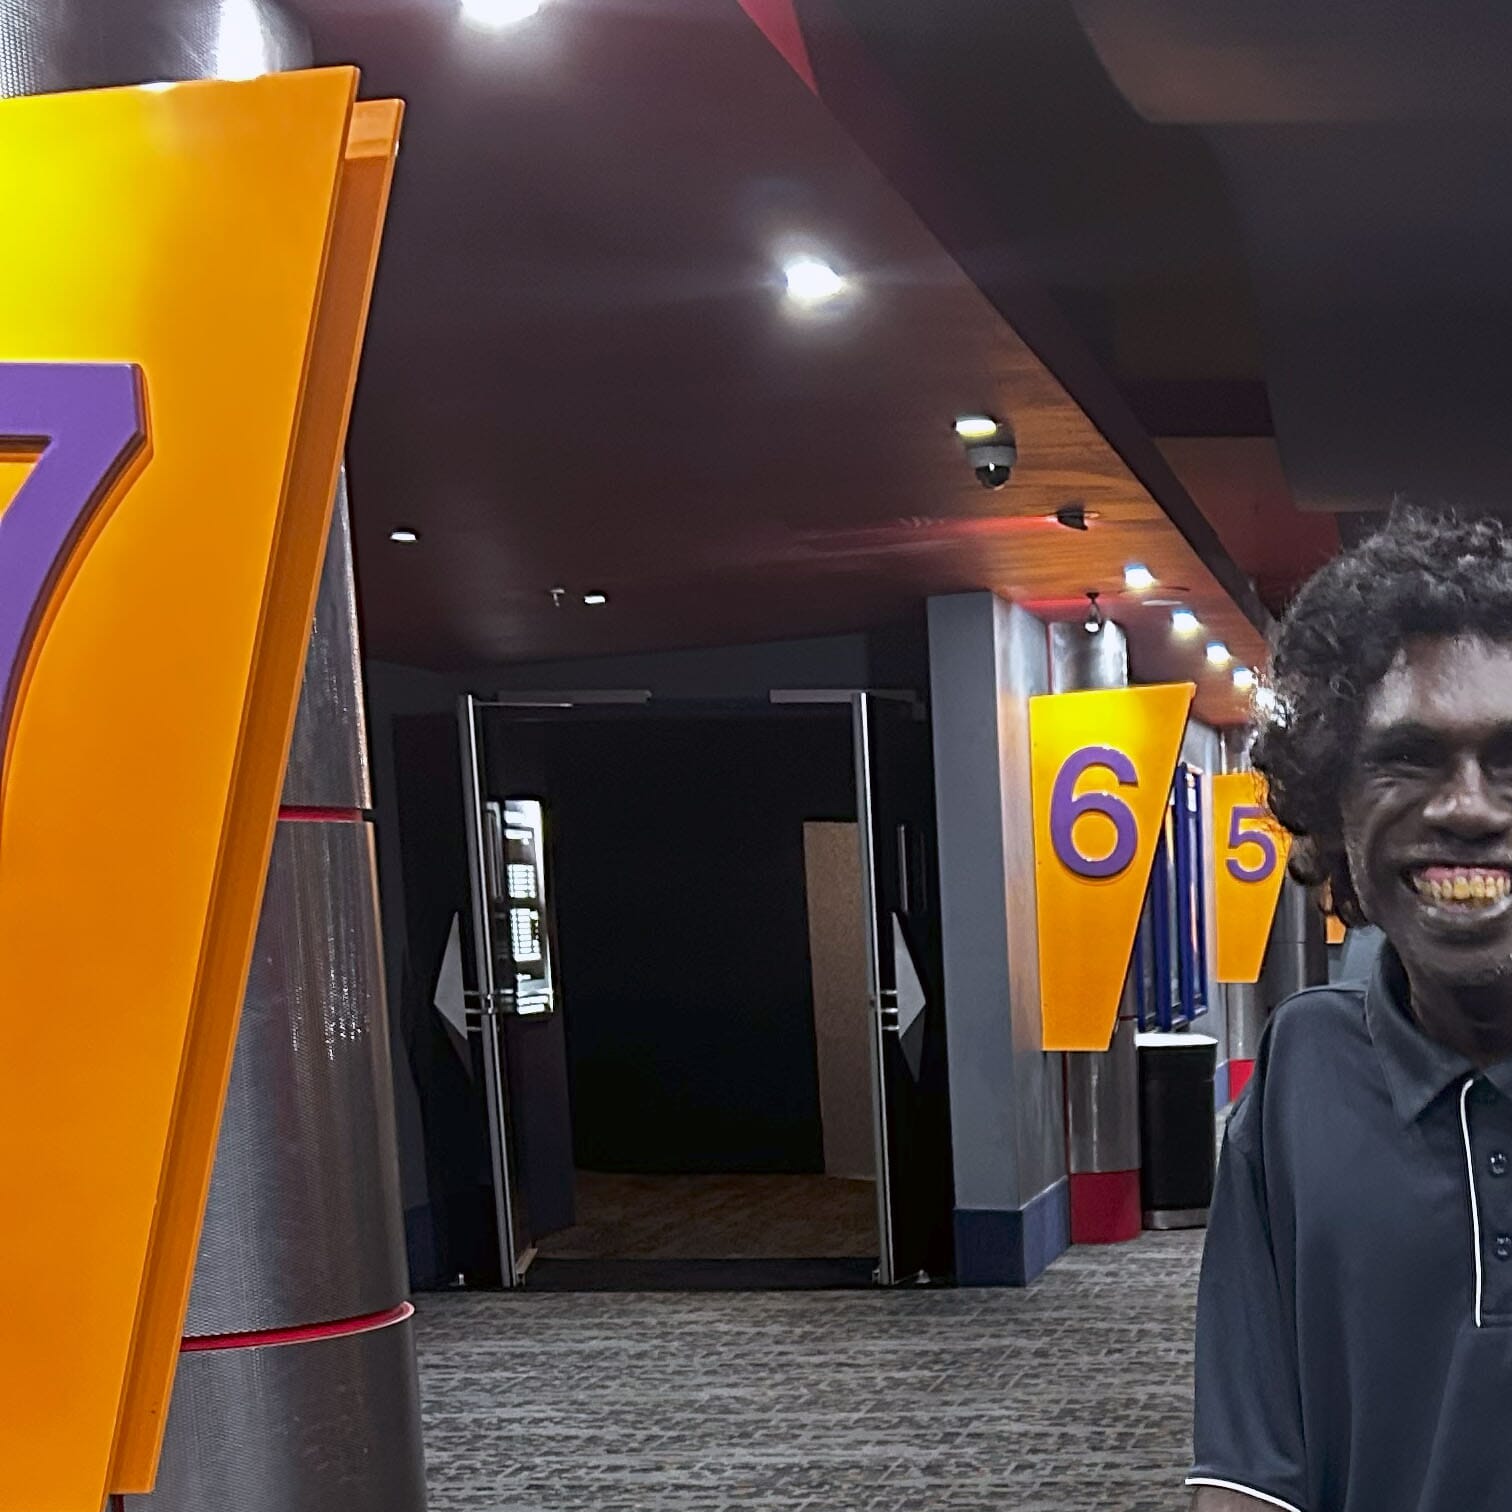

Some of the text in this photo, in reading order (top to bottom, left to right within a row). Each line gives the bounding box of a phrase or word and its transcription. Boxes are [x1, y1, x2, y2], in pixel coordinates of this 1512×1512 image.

[0, 363, 147, 760] 7
[1050, 746, 1138, 878] 6
[1226, 806, 1276, 882] 5
